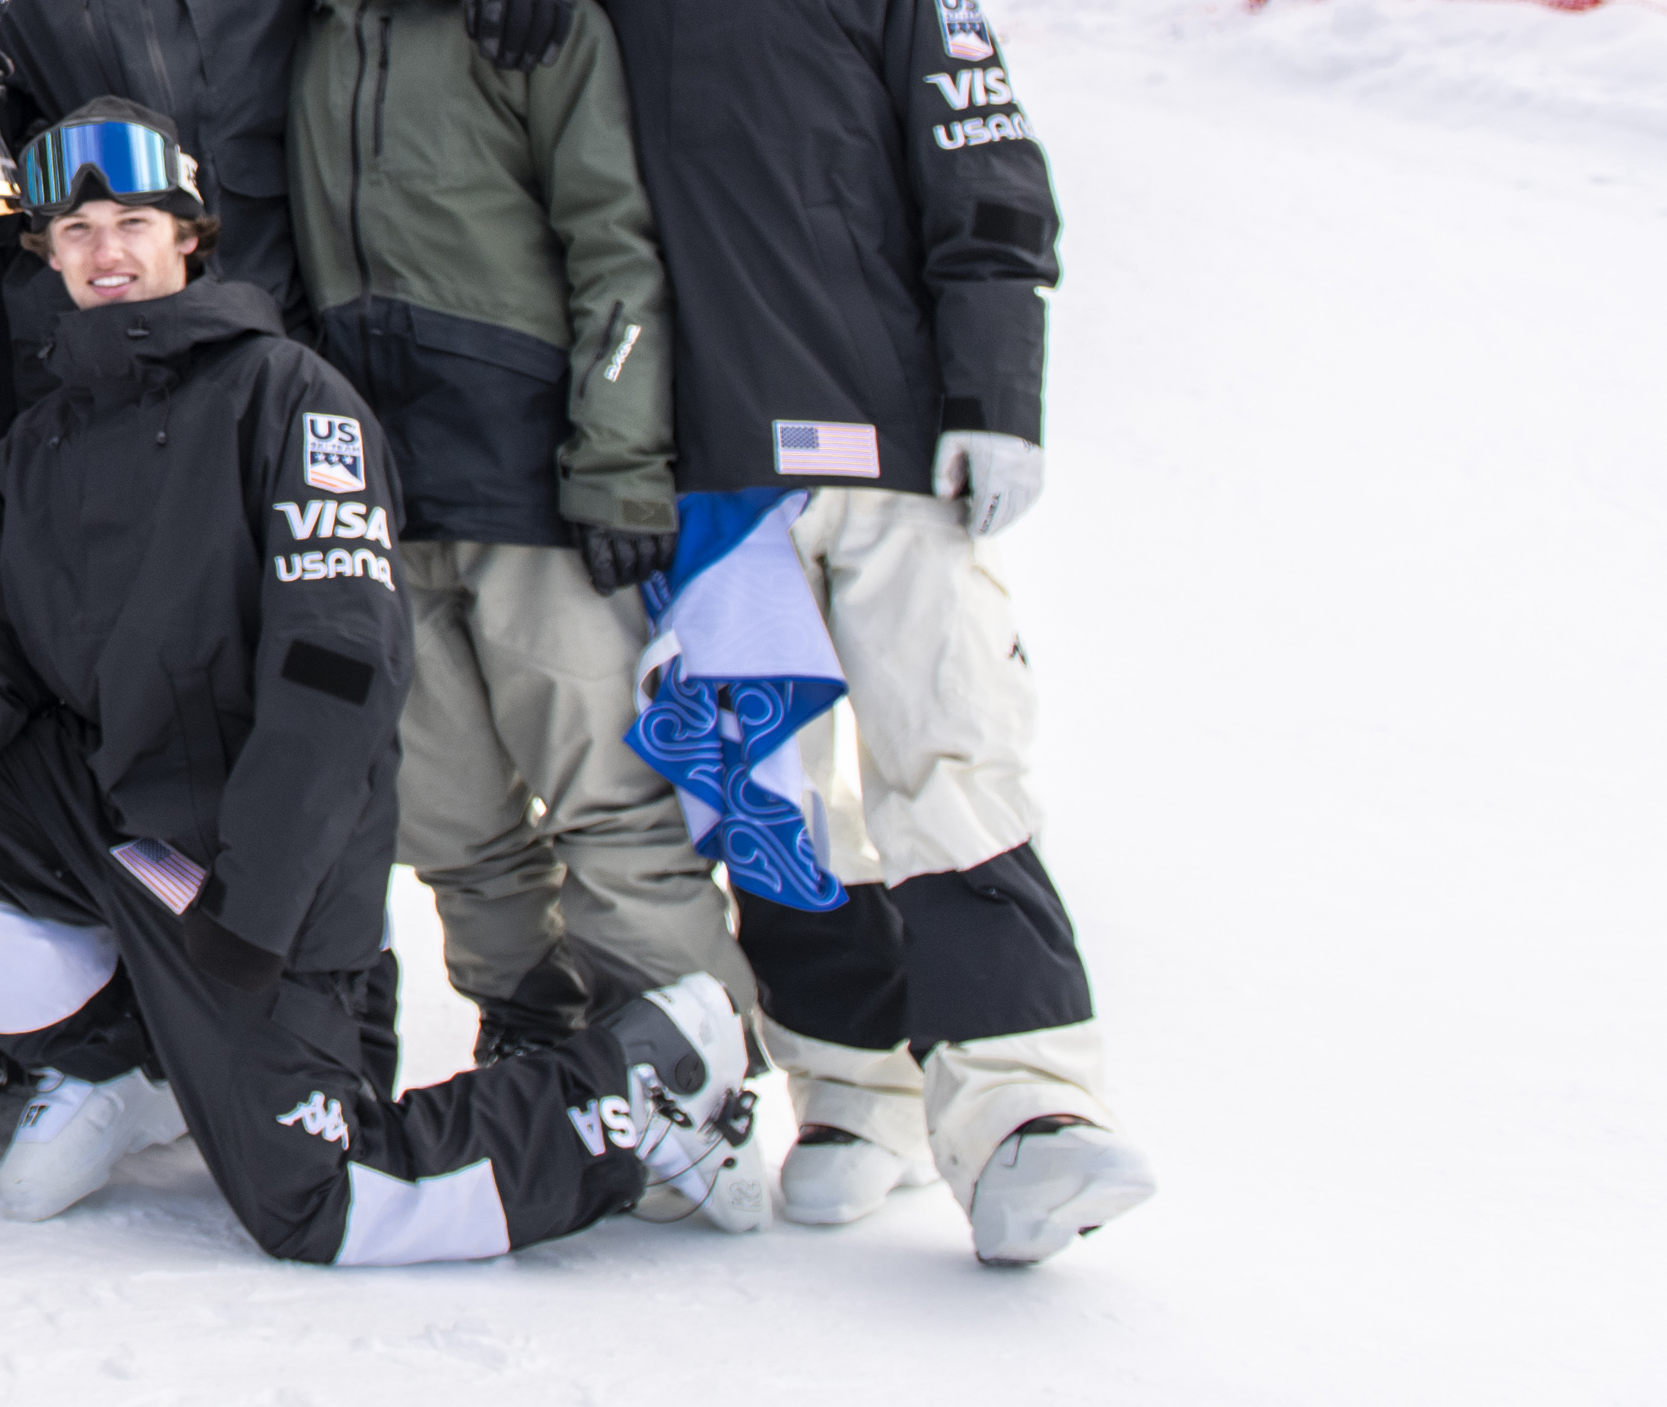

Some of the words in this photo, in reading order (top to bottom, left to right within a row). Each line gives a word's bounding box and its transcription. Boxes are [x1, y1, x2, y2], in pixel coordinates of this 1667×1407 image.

[922, 66, 1013, 110] VIS
[310, 418, 359, 444] US
[272, 499, 392, 550] VISA
[274, 548, 396, 592] USANA
